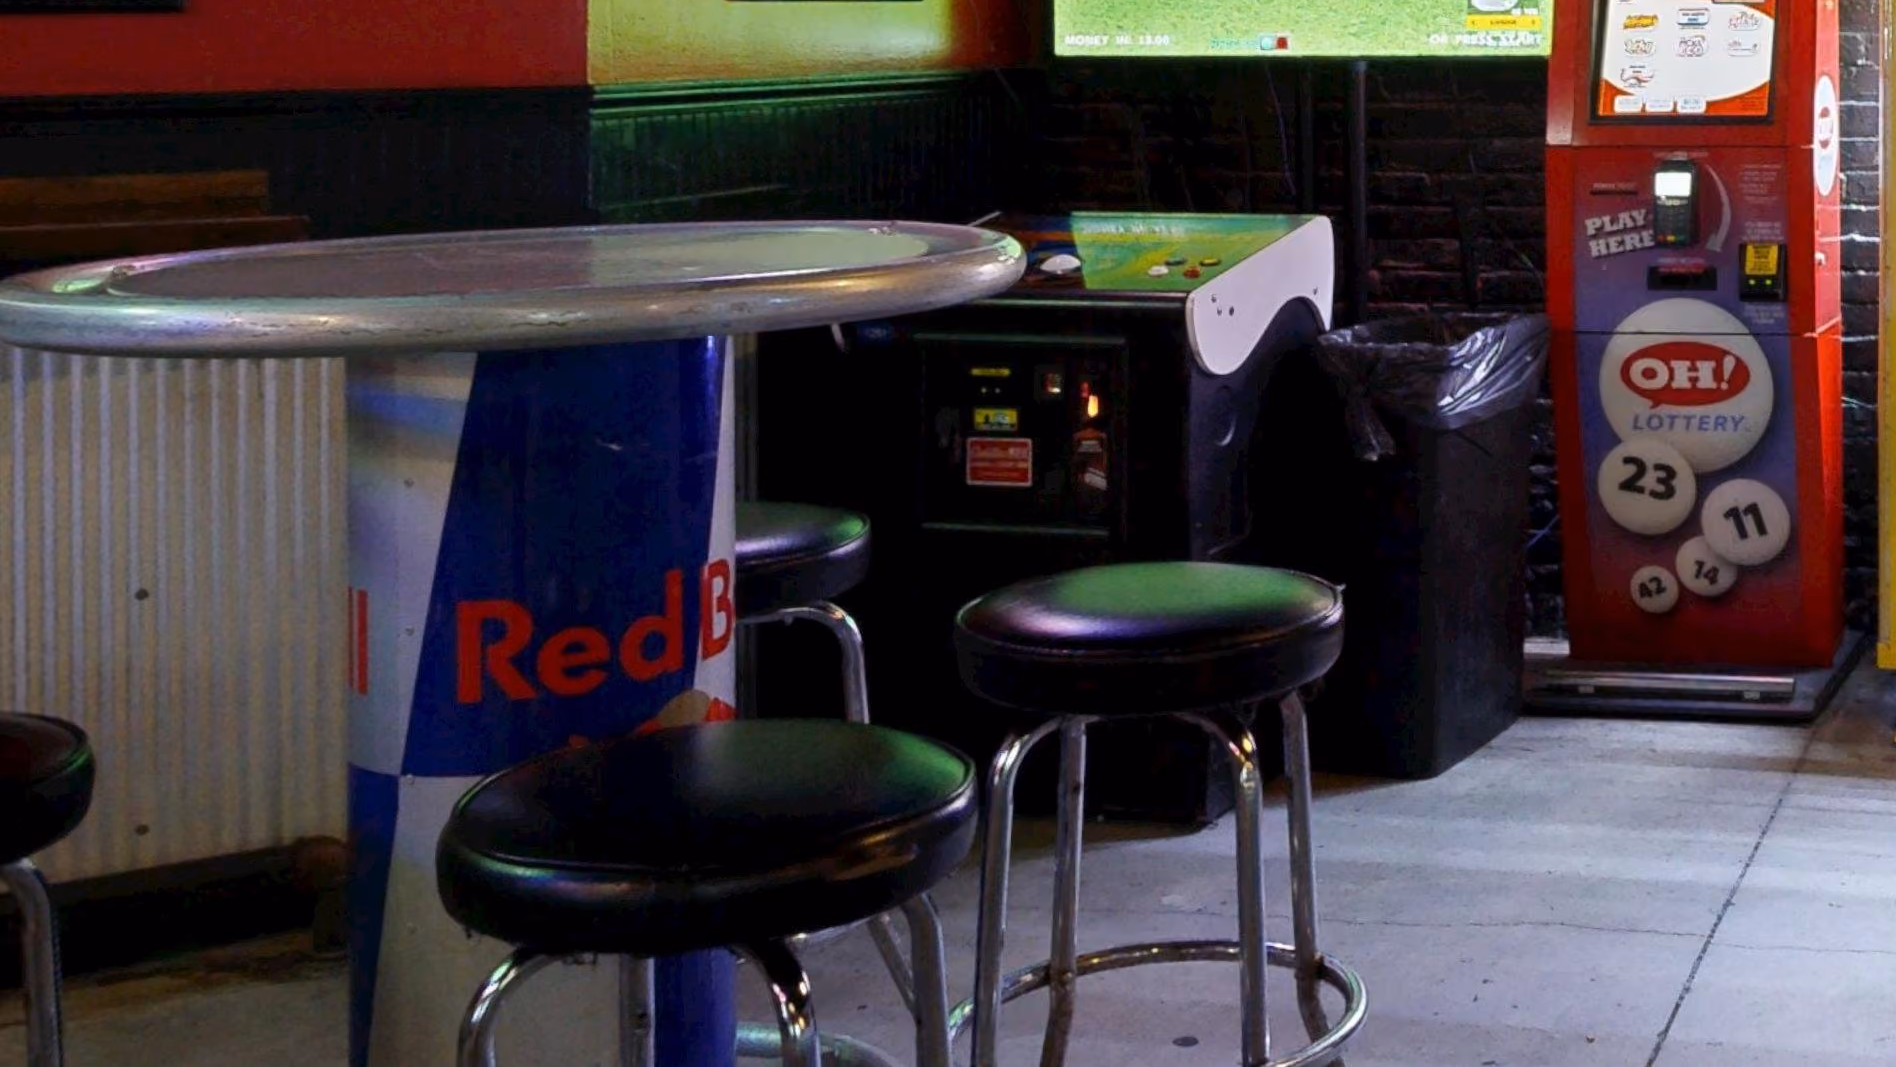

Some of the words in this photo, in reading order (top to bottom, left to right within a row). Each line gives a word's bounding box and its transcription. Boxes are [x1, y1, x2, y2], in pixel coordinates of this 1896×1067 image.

[1064, 34, 1109, 47] MONEY
[1584, 208, 1647, 236] PLAY
[1588, 229, 1655, 258] HERE
[1627, 354, 1737, 391] OH!
[1632, 413, 1746, 432] LOTTERY
[1617, 455, 1678, 501] 23
[1722, 501, 1769, 541] 11
[1693, 559, 1720, 586] 14
[1637, 576, 1667, 600] 42
[456, 567, 685, 705] Red
